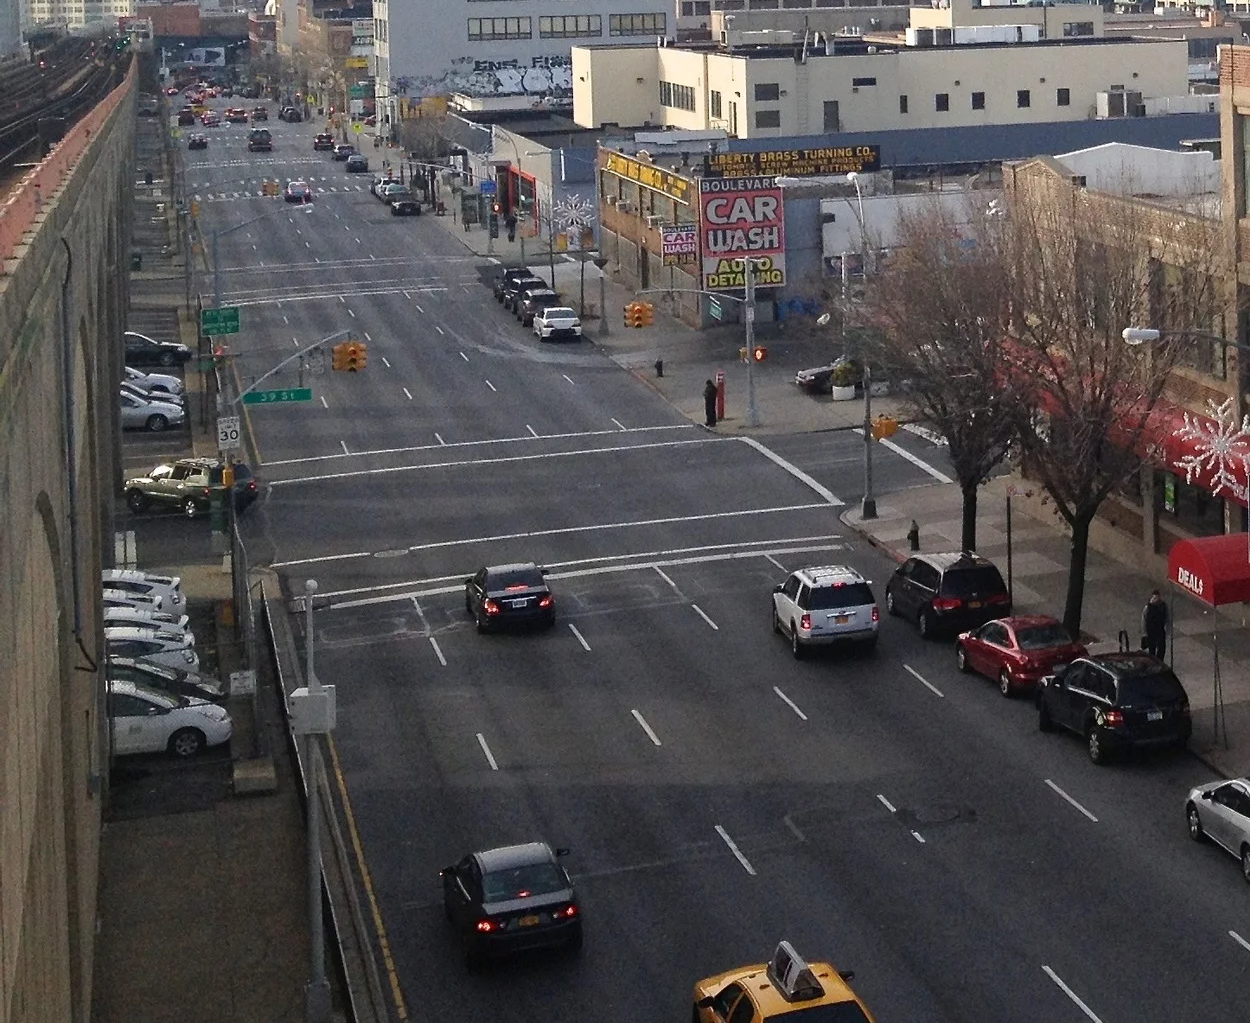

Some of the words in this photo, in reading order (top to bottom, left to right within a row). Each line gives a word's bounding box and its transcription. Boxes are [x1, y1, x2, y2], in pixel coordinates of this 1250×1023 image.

[708, 153, 754, 165] LIBERTY
[759, 150, 799, 162] BRASS
[803, 148, 853, 159] TURNING
[831, 155, 874, 165] PRODUCTS
[706, 196, 778, 224] CAR
[663, 233, 696, 243] CAR
[707, 226, 779, 252] WASH
[663, 243, 696, 254] WASH
[220, 429, 238, 441] 30
